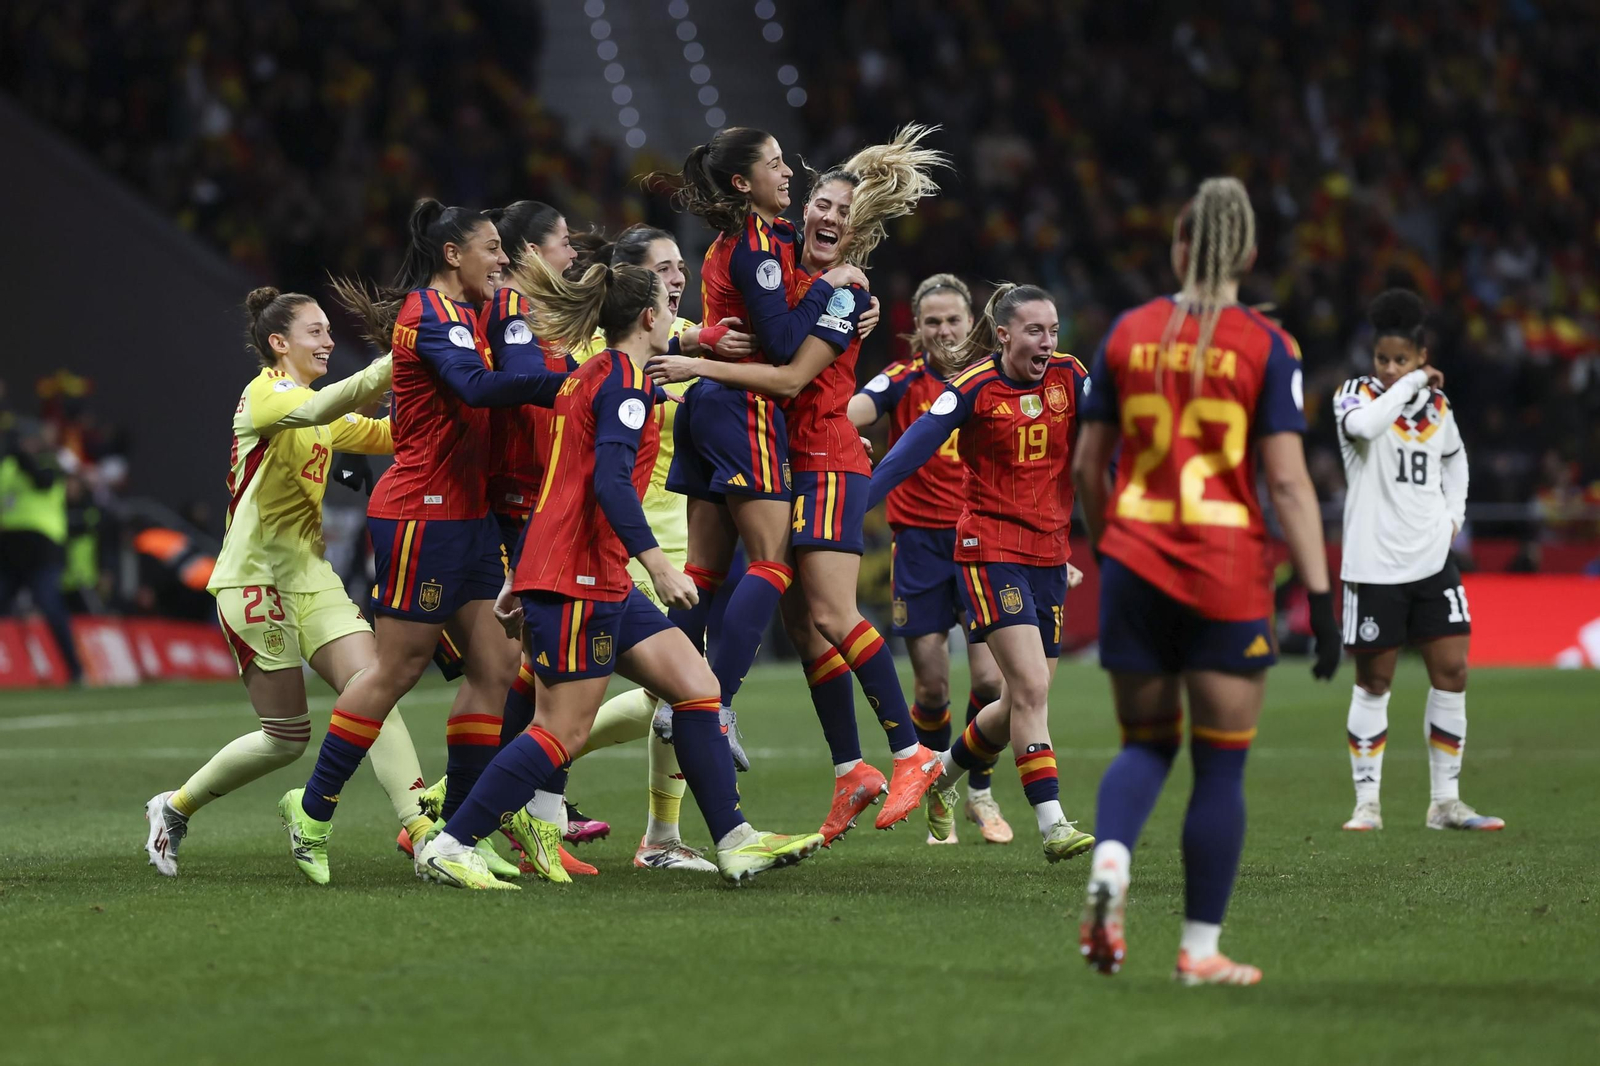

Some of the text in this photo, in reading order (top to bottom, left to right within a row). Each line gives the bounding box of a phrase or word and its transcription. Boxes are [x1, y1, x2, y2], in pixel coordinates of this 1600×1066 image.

[301, 442, 329, 484] 23
[1017, 423, 1048, 463] 19
[1116, 393, 1250, 529] 22
[1396, 447, 1428, 485] 18
[243, 585, 286, 624] 23
